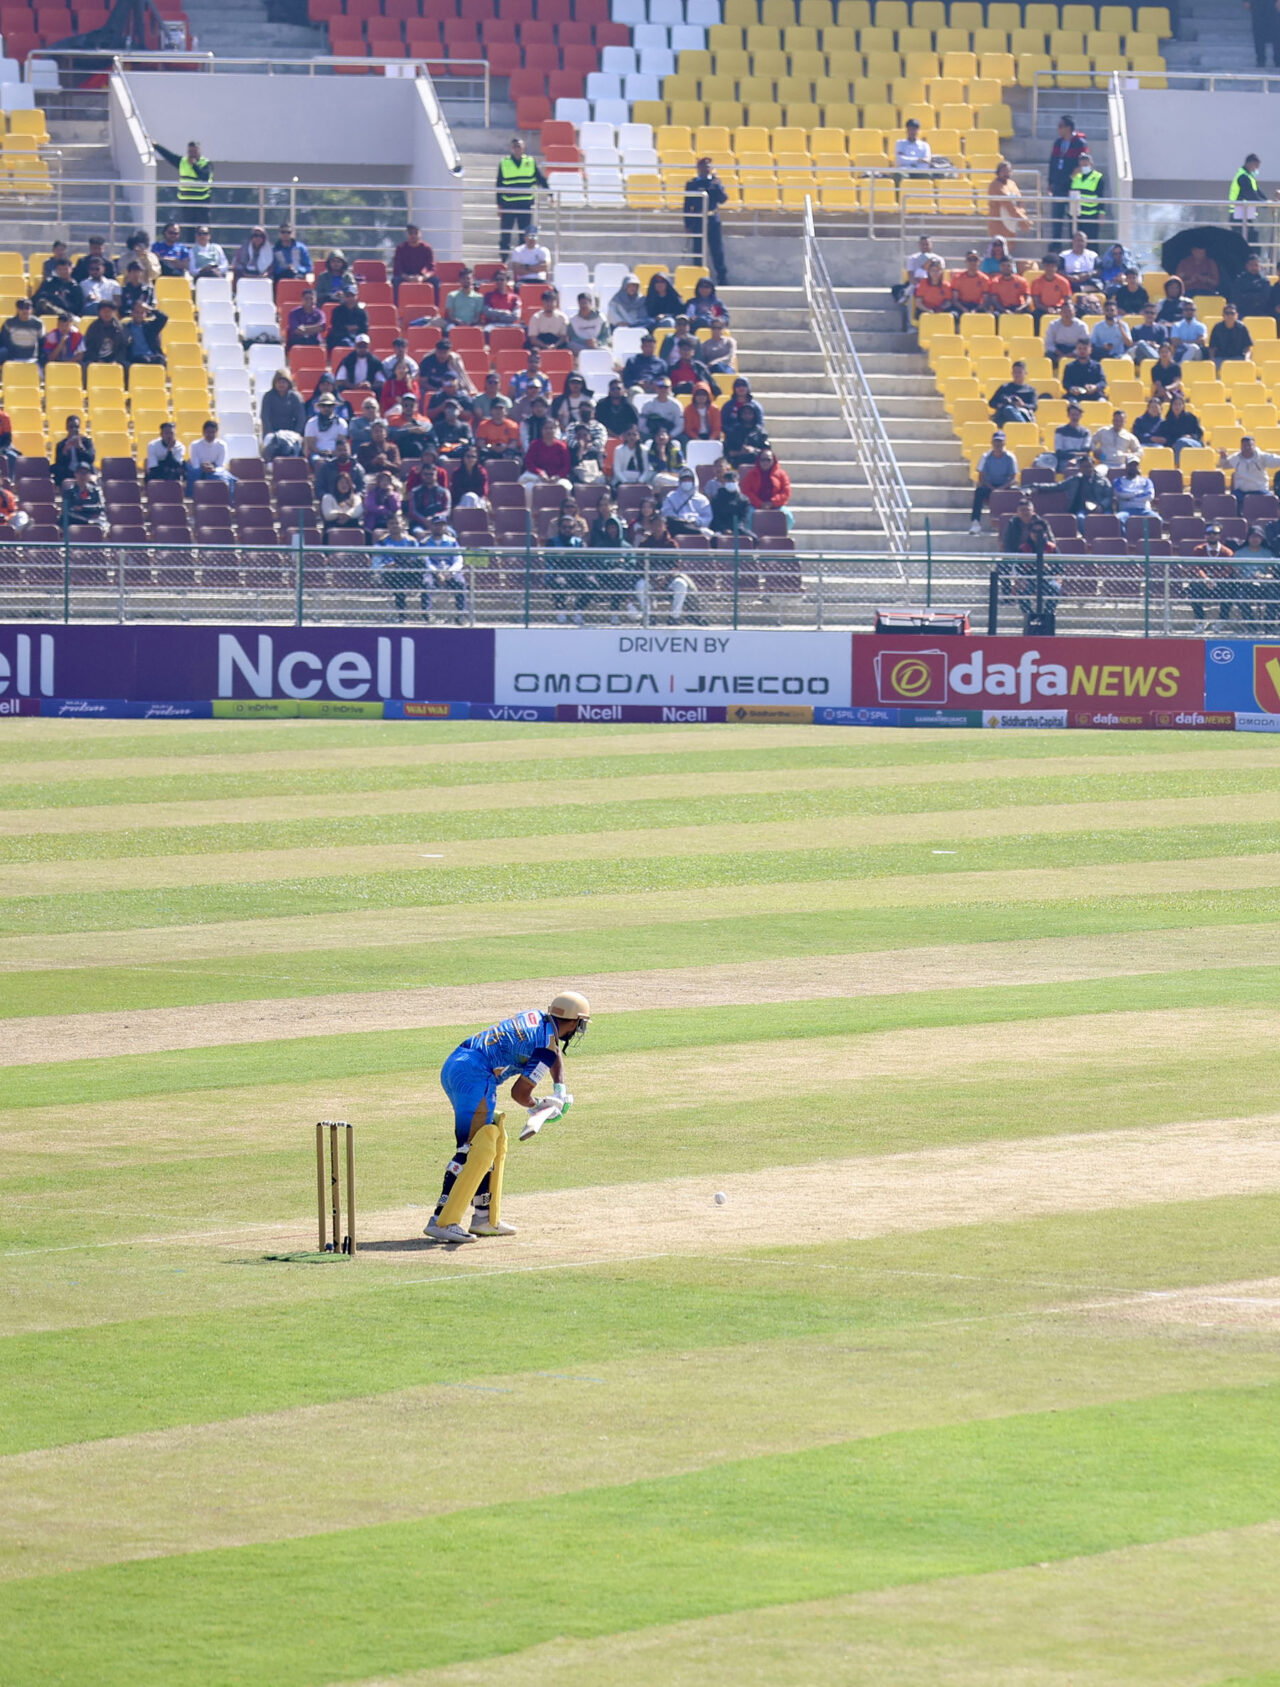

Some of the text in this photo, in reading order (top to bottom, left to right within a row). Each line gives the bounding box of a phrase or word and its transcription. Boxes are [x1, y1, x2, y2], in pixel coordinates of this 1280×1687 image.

[619, 637, 730, 653] DRIVEN BY
[1213, 650, 1232, 660] CG
[218, 633, 415, 699] Ncell
[514, 673, 830, 695] OMODA JAECOO
[488, 706, 538, 721] vivo
[578, 705, 622, 720] Ncell
[662, 707, 707, 722] Ncell
